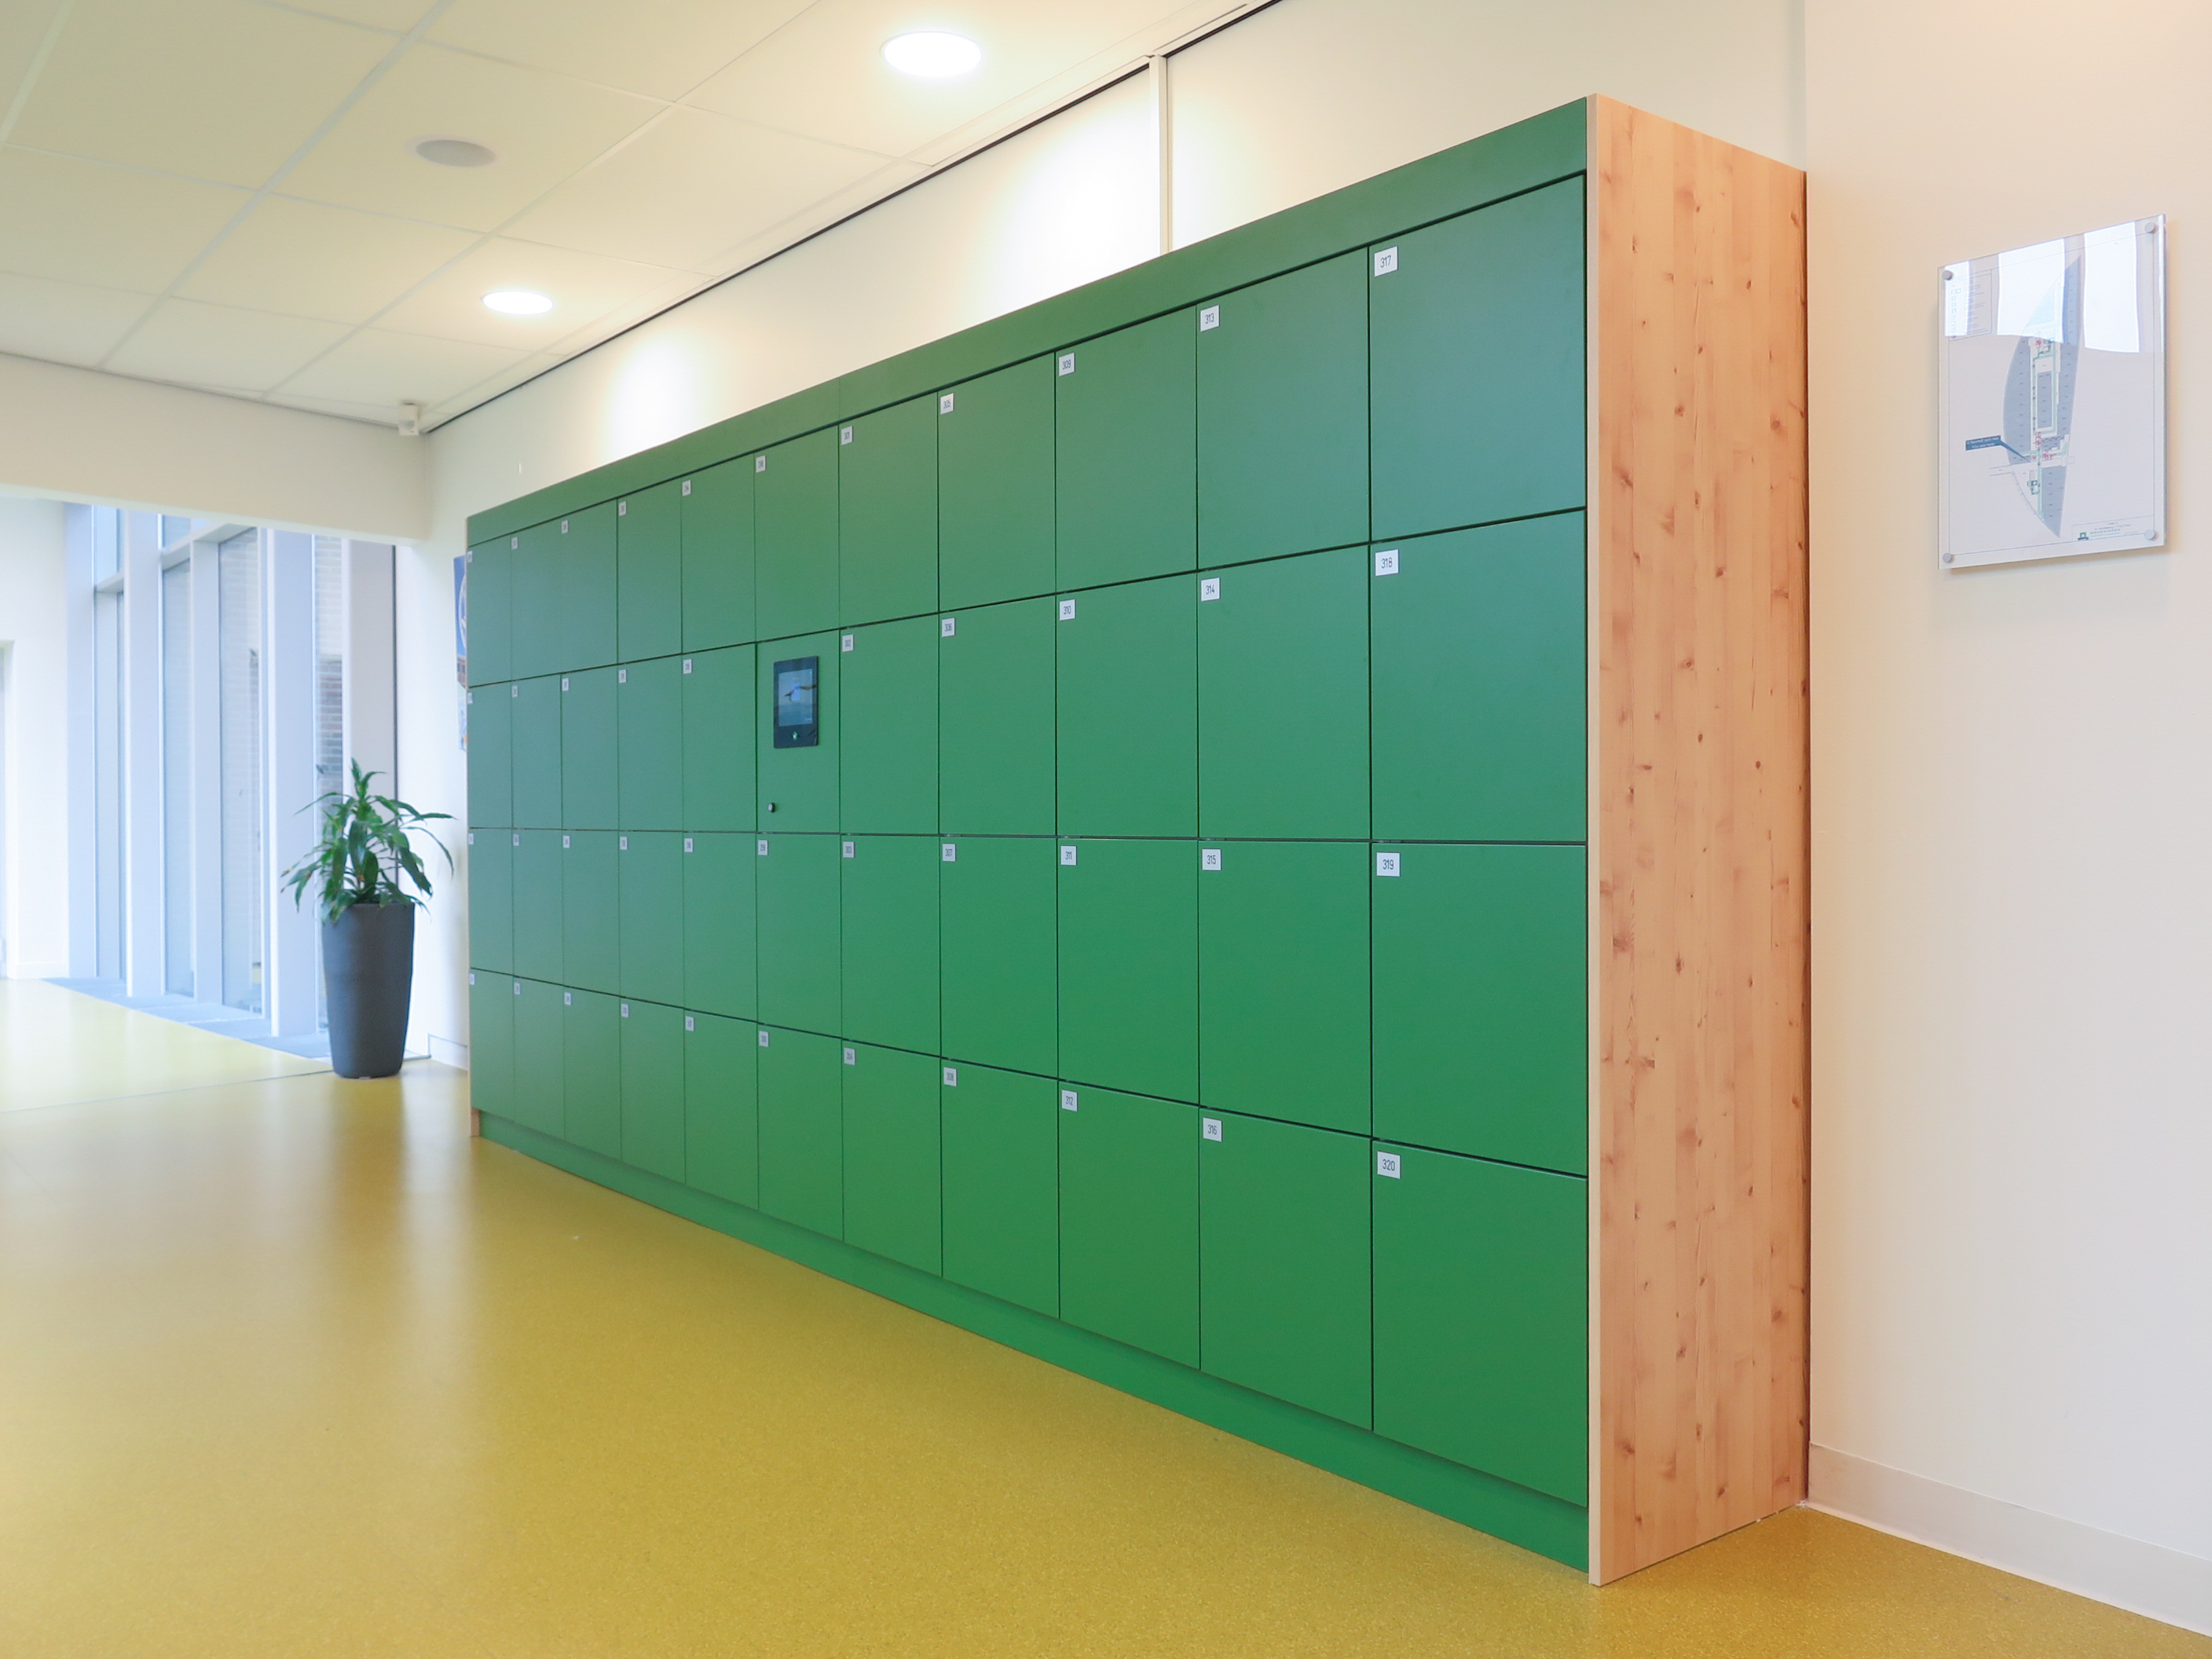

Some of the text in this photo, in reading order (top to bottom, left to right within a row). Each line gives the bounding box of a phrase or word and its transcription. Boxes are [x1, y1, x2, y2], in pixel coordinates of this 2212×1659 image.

[1380, 255, 1392, 269] 317
[1205, 313, 1215, 324] 313
[1062, 360, 1071, 370] 309
[1381, 558, 1393, 569] 318
[1206, 585, 1215, 595] 314
[1063, 606, 1071, 615] 310
[1207, 855, 1217, 865] 315
[1382, 859, 1394, 870] 319
[1065, 1096, 1074, 1106] 312
[1207, 1125, 1218, 1135] 316
[1382, 1159, 1396, 1172] 320
